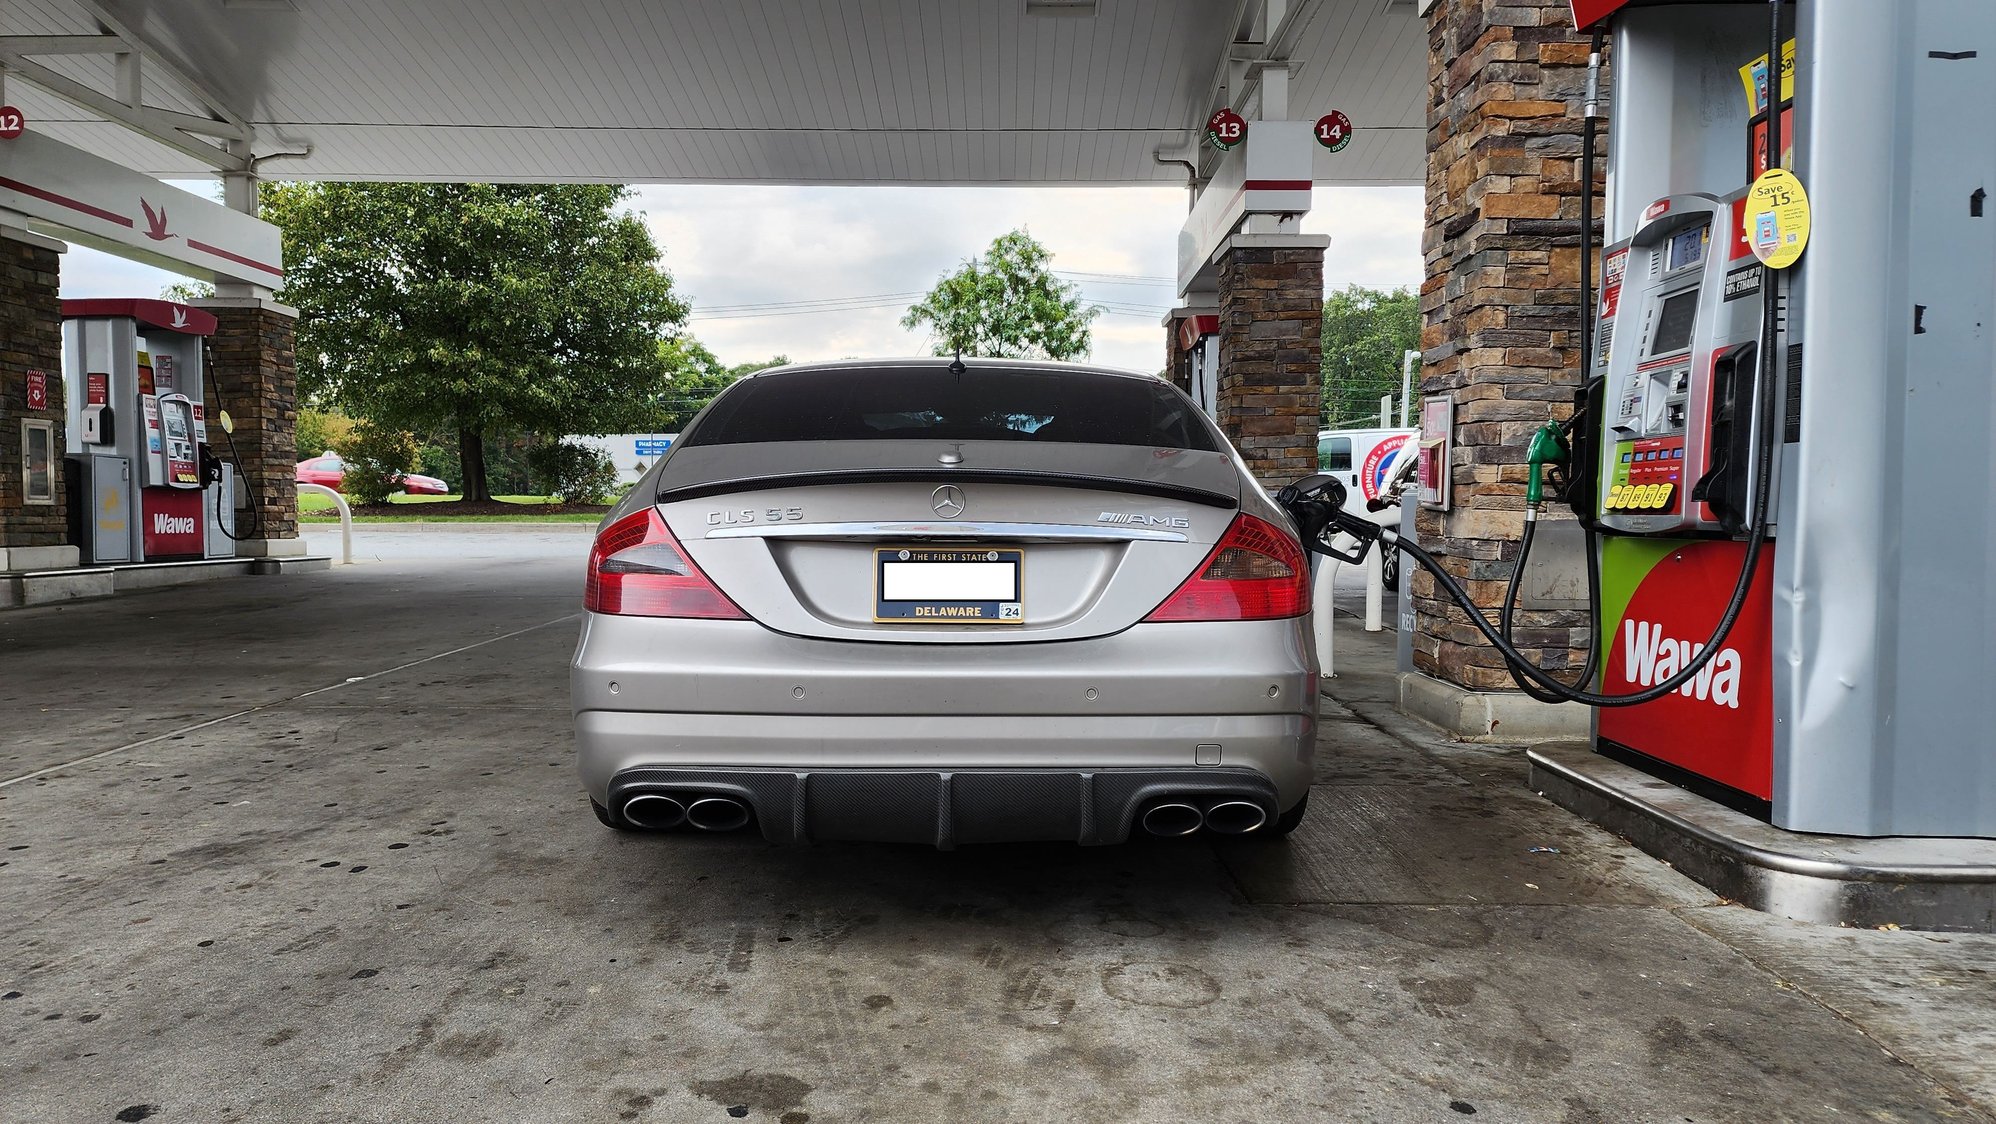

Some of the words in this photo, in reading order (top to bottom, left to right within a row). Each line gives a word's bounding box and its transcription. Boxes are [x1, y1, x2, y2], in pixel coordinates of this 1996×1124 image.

[0, 115, 20, 131] 12
[1213, 111, 1226, 124] GAS
[1337, 113, 1350, 127] GAS
[1219, 122, 1240, 138] 13
[1320, 124, 1342, 139] 14
[1209, 131, 1228, 150] DIESEL
[1332, 134, 1351, 152] DIESEL
[1757, 184, 1784, 197] Save
[1727, 270, 1748, 285] CONTAINS
[1748, 268, 1755, 278] UP
[1755, 266, 1762, 276] TO
[1725, 283, 1736, 295] 10%
[1736, 276, 1760, 292] ETHANOL
[31, 375, 43, 383] FIRE
[194, 408, 203, 418] 12
[1365, 455, 1379, 499] FURNITURE
[1620, 493, 1629, 502] 87
[1632, 493, 1641, 502] 89
[1644, 492, 1653, 502] 91
[1657, 492, 1667, 502] 93
[706, 509, 755, 526] CLS
[766, 506, 804, 522] 55
[1127, 514, 1189, 529] AMG
[154, 513, 195, 534] Wawa
[912, 553, 929, 561] THE
[933, 553, 957, 561] FIRST
[961, 553, 987, 562] STATE
[915, 606, 983, 617] DELAWARE
[1005, 607, 1020, 617] 24
[1625, 619, 1742, 709] Wawa
